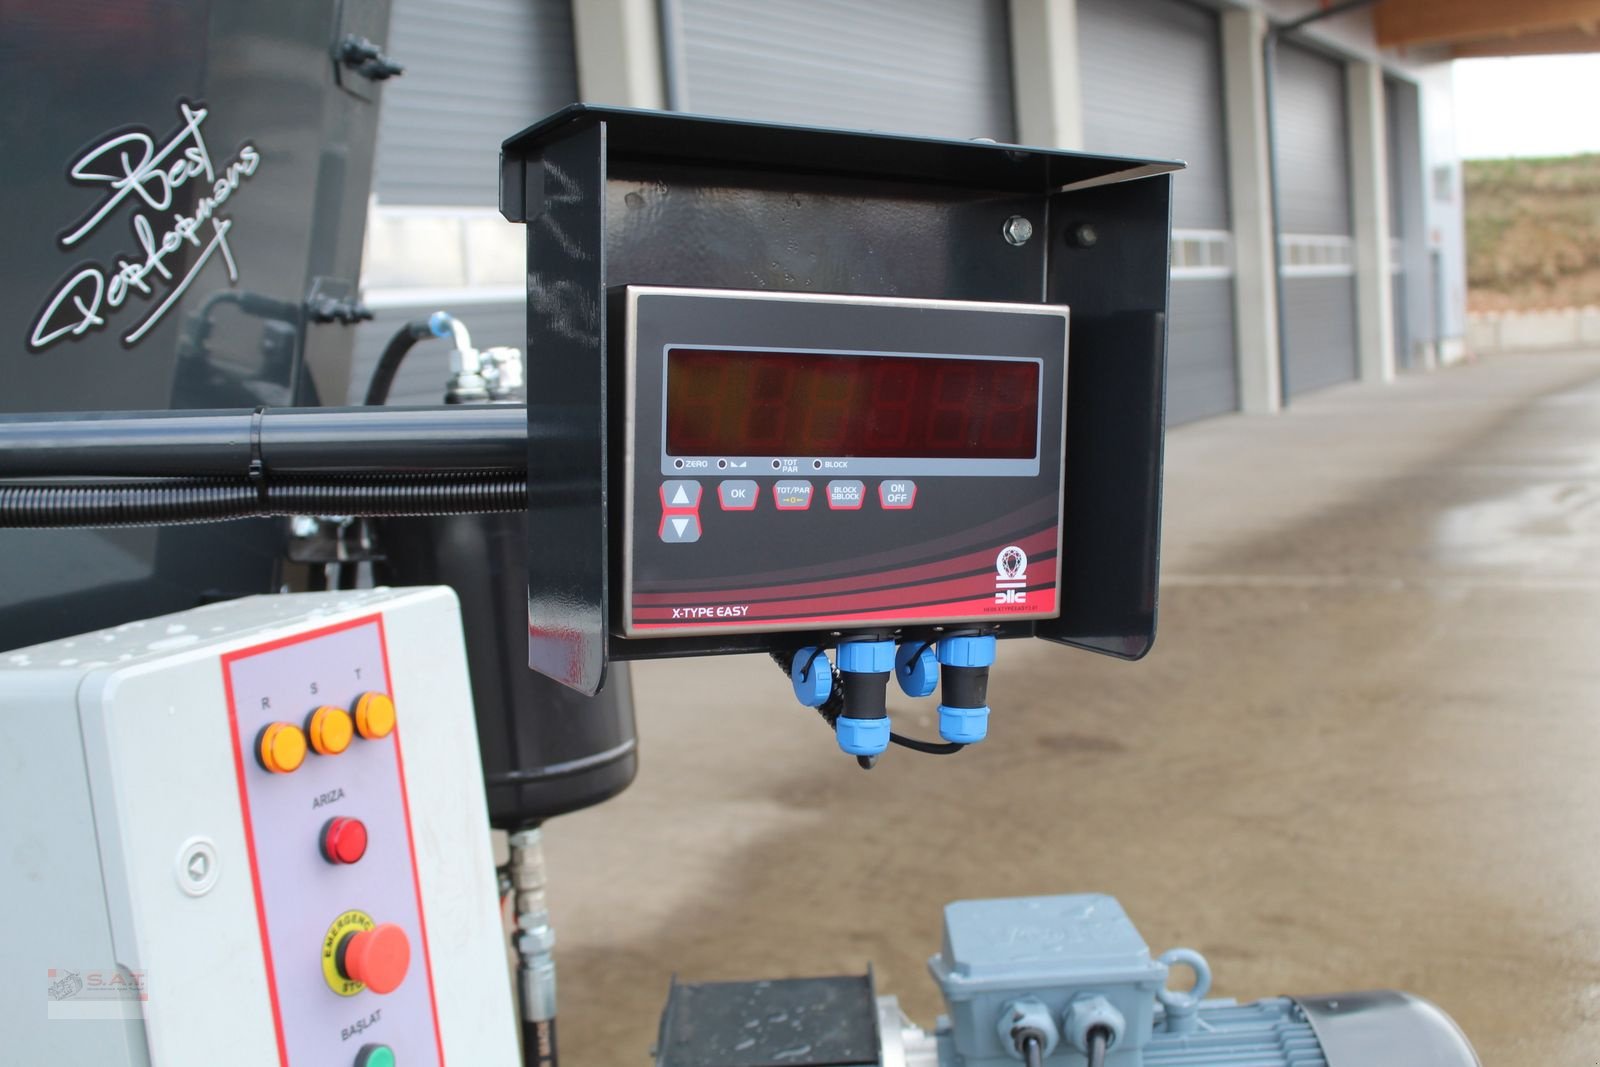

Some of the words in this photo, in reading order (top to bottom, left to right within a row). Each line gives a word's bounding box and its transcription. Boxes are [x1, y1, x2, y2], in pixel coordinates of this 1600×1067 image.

[685, 460, 708, 468] ZERO
[824, 461, 848, 469] BLOCK
[776, 486, 810, 494] TOT/PAR
[833, 486, 857, 494] BLOCK
[890, 484, 905, 493] ON
[730, 489, 746, 499] OK
[887, 493, 907, 503] OFF
[672, 607, 714, 619] X-TYPE
[716, 606, 749, 617] EASY
[354, 668, 361, 680] T
[310, 682, 318, 694] S
[261, 697, 270, 709] R
[312, 788, 345, 809] ARIZA
[341, 1009, 381, 1041] BAŞLAT
